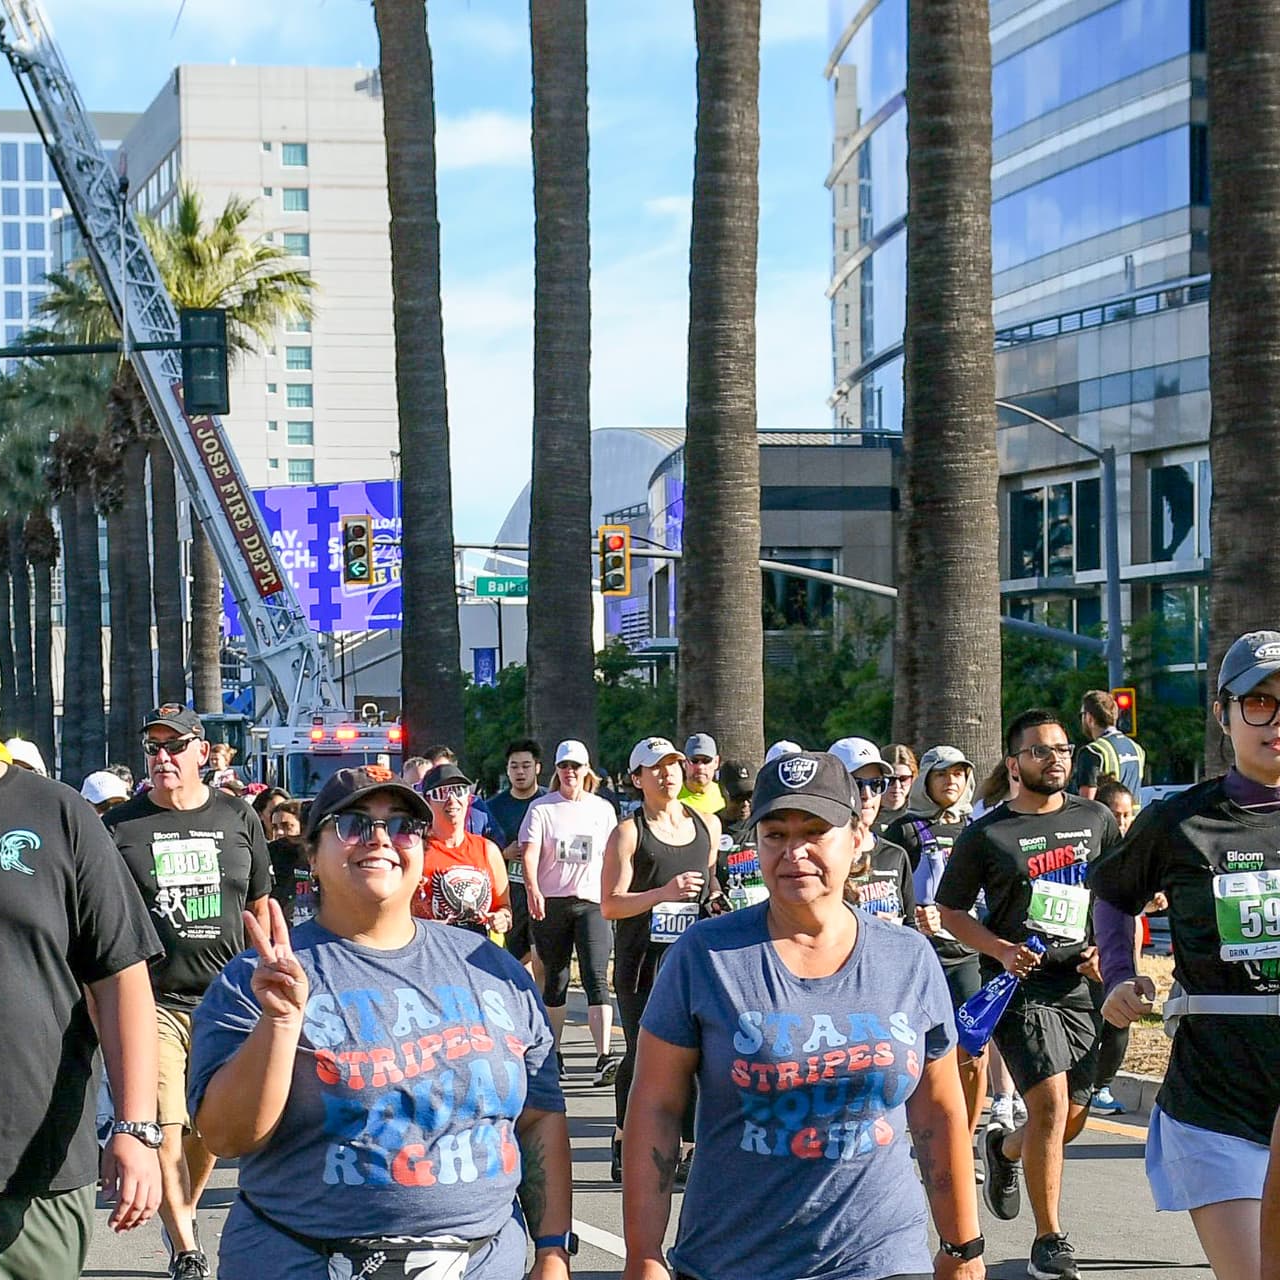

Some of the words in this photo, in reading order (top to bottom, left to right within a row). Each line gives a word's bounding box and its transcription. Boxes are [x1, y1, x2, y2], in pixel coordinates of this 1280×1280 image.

[196, 428, 230, 479] JOSE
[220, 482, 253, 532] FIRE
[243, 534, 277, 591] DEPT.
[272, 530, 302, 549] AY.
[280, 550, 316, 569] CH.
[727, 849, 755, 865] STARS
[728, 859, 760, 874] STRIDE
[1028, 845, 1075, 878] STARS
[1227, 851, 1264, 862] Bloom
[1228, 862, 1264, 871] energy
[858, 880, 889, 902] STARS
[186, 893, 221, 920] RUN
[304, 985, 515, 1047] STARS
[733, 1011, 917, 1056] STARS
[314, 1026, 494, 1090] STRIPES
[731, 1042, 894, 1092] STRIPES
